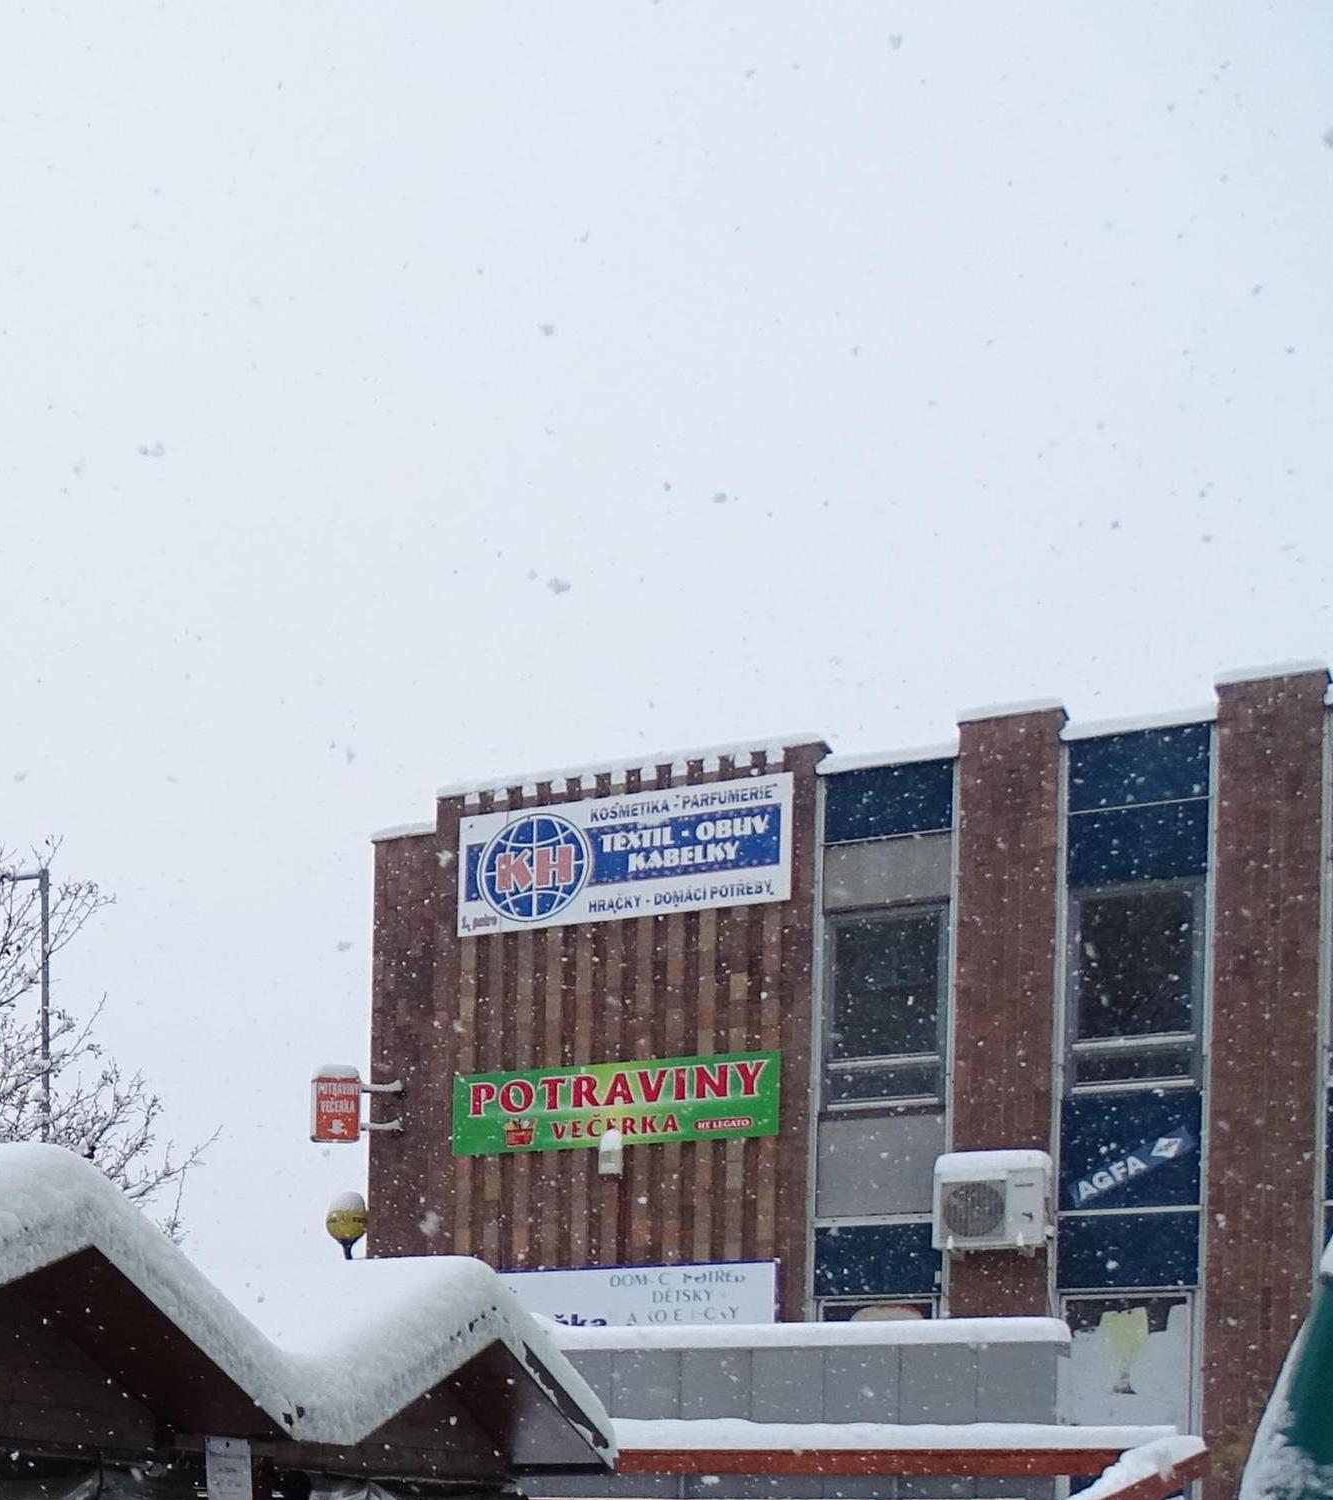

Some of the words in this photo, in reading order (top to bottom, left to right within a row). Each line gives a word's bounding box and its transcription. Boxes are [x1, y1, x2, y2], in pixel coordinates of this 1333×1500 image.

[589, 799, 670, 823] KOSMETIKA
[682, 785, 773, 810] PARFUMERIE
[600, 827, 675, 852] TEXTIL
[695, 814, 770, 842] OBUV
[496, 843, 575, 893] KH
[628, 841, 741, 873] KABELKY
[587, 893, 642, 914] HRAČKY
[653, 885, 708, 907] DOMÁCÍ
[709, 878, 773, 903] POTŘEBY
[469, 1059, 770, 1118] POTRAVINY
[550, 1112, 680, 1141] VEČERKA
[1076, 1154, 1148, 1201] AGFA
